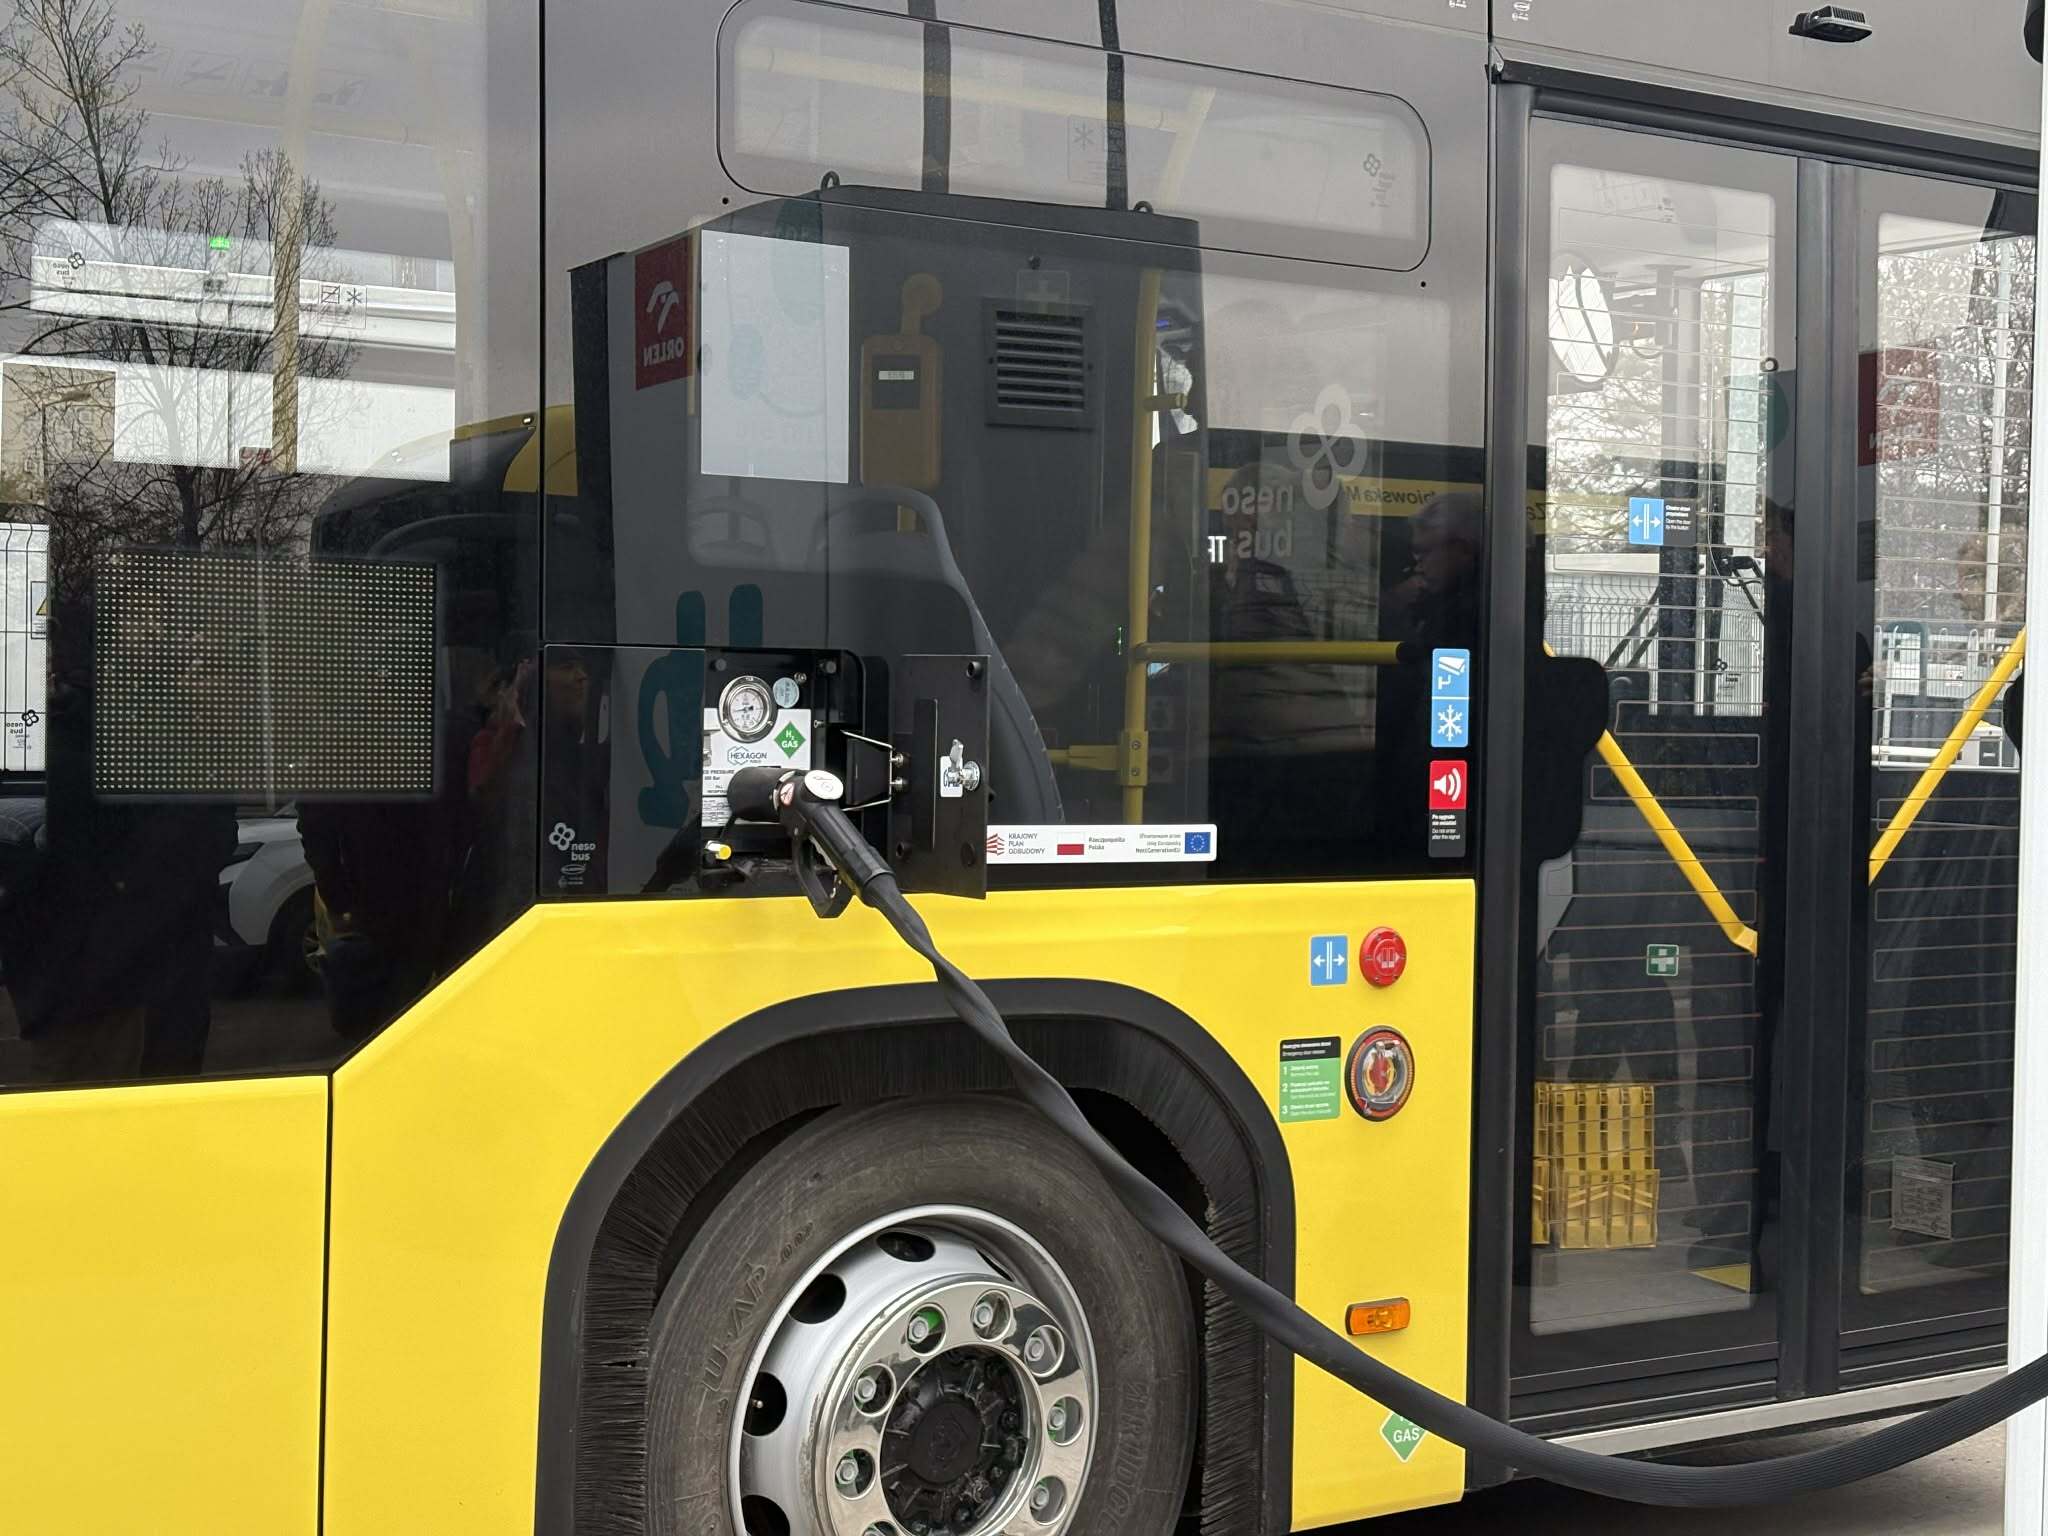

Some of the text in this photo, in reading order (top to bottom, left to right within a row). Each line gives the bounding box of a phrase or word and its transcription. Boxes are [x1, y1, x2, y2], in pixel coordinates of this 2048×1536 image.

[781, 740, 798, 748] GAS
[571, 843, 597, 851] neso
[1008, 847, 1046, 855] ODBUDOWY
[571, 851, 591, 861] bus
[1281, 1083, 1289, 1093] 2
[1281, 1105, 1289, 1115] 3
[1393, 1427, 1420, 1443] GAS
